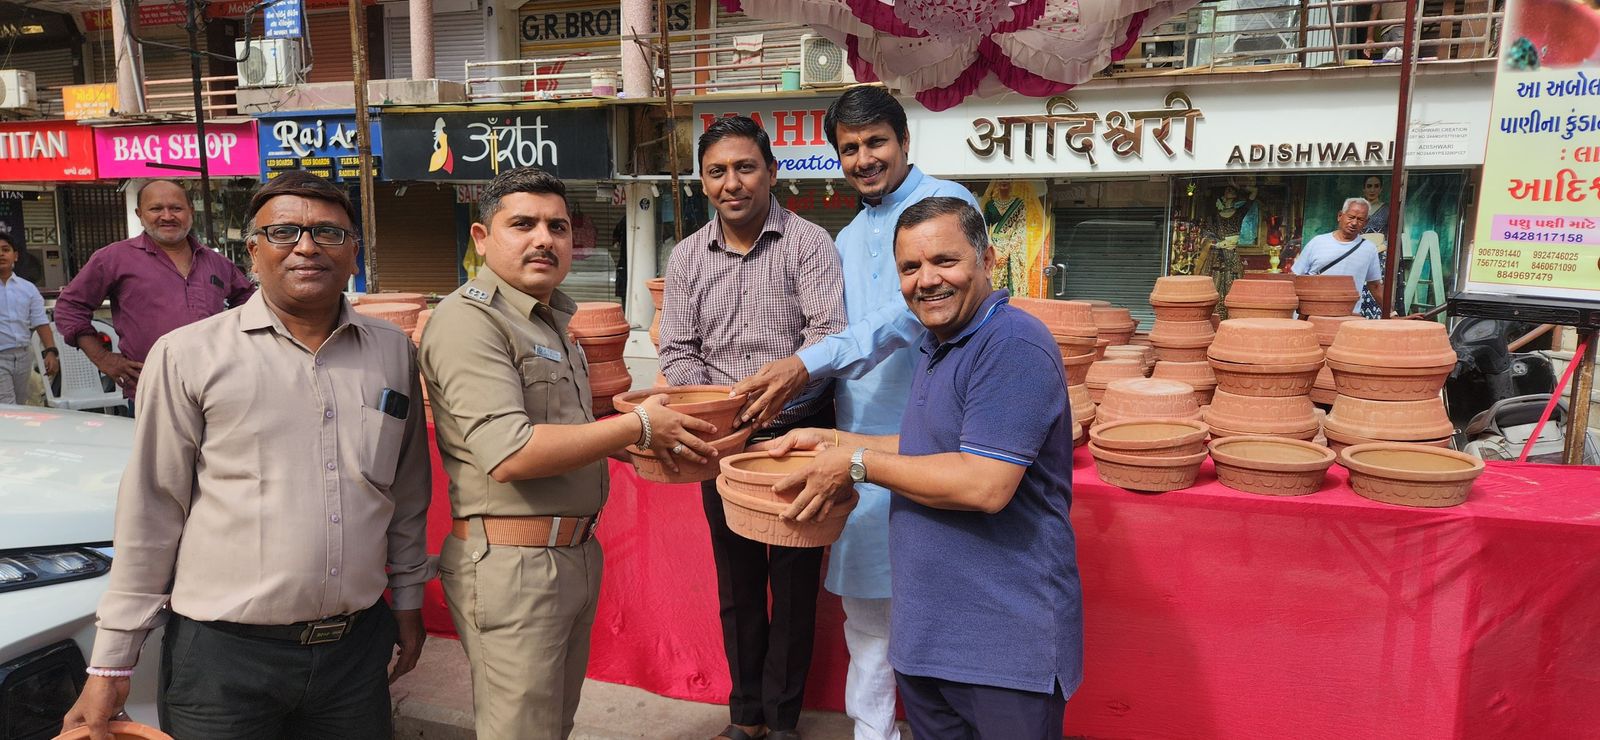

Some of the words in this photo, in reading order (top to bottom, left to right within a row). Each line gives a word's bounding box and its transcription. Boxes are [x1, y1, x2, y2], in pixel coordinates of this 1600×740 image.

[522, 3, 689, 41] G.R.BROTS
[1516, 81, 1541, 98] આ
[1500, 109, 1560, 134] પાણીના
[1561, 108, 1600, 140] કુંડા
[273, 120, 323, 157] Raj
[113, 134, 163, 164] BAG
[168, 132, 238, 165] SHOP
[1226, 140, 1395, 165] ADISHWARI
[778, 155, 842, 171] reatio
[1508, 218, 1531, 230] પશુ
[1535, 217, 1565, 228] પક્ષી
[1568, 218, 1597, 230] માટે
[1504, 231, 1584, 243] 9428117158
[1478, 248, 1521, 258] 9067891440
[1532, 250, 1579, 261] 9924746025
[1477, 258, 1520, 268] 7567752141
[1531, 261, 1577, 272] 8460671090
[1496, 270, 1554, 281] 8849697479
